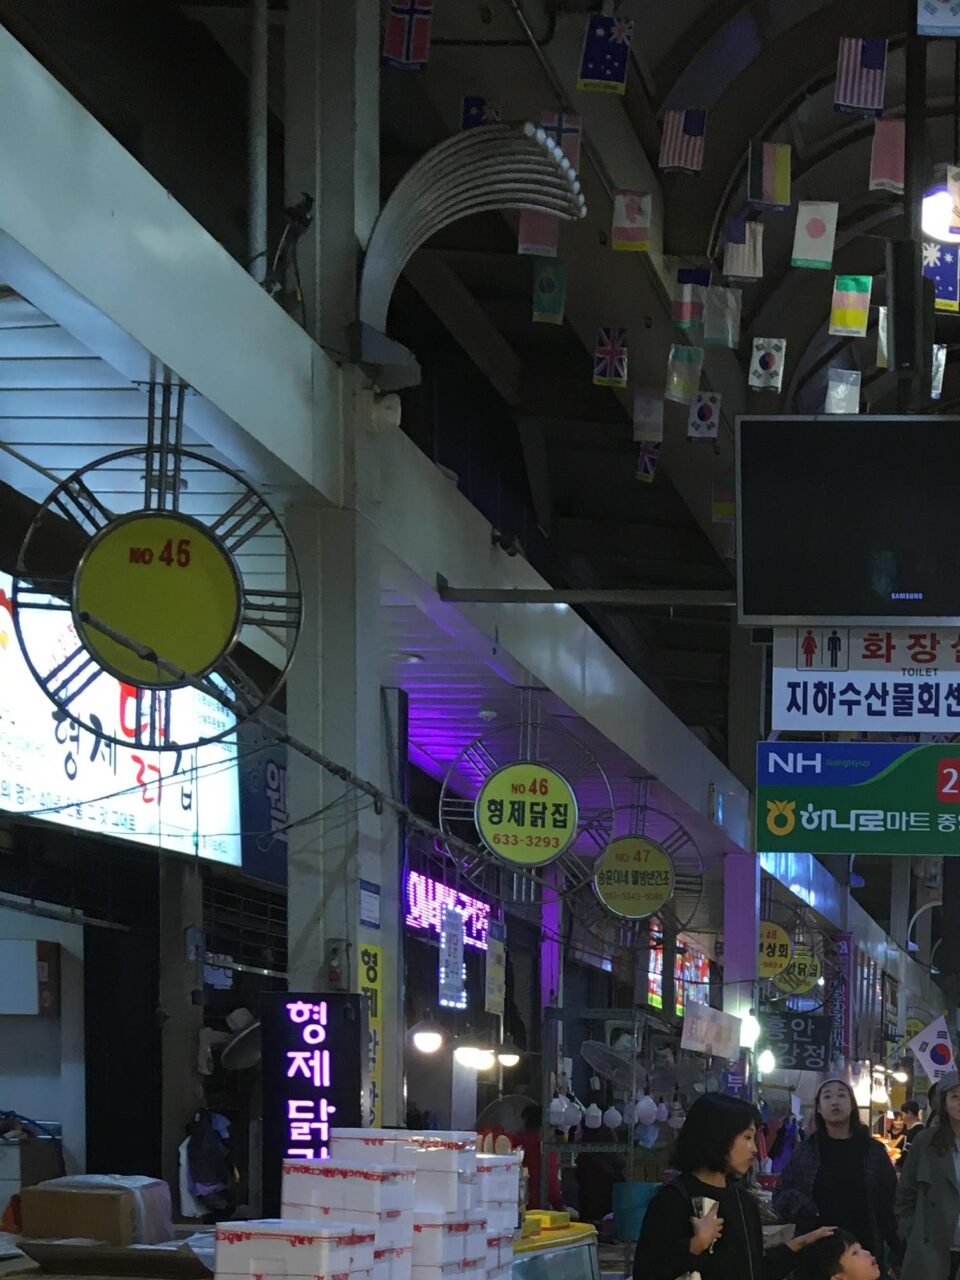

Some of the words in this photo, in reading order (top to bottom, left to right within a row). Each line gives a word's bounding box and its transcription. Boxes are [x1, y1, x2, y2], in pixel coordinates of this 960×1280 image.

[129, 547, 154, 565] NO
[900, 667, 939, 678] TOILET
[768, 752, 822, 774] NH
[825, 758, 871, 769] NongHyup
[511, 783, 526, 796] NO
[528, 777, 549, 797] 46
[486, 798, 569, 830] 형제닭집
[492, 833, 561, 849] 633-3293
[633, 849, 650, 863] 47
